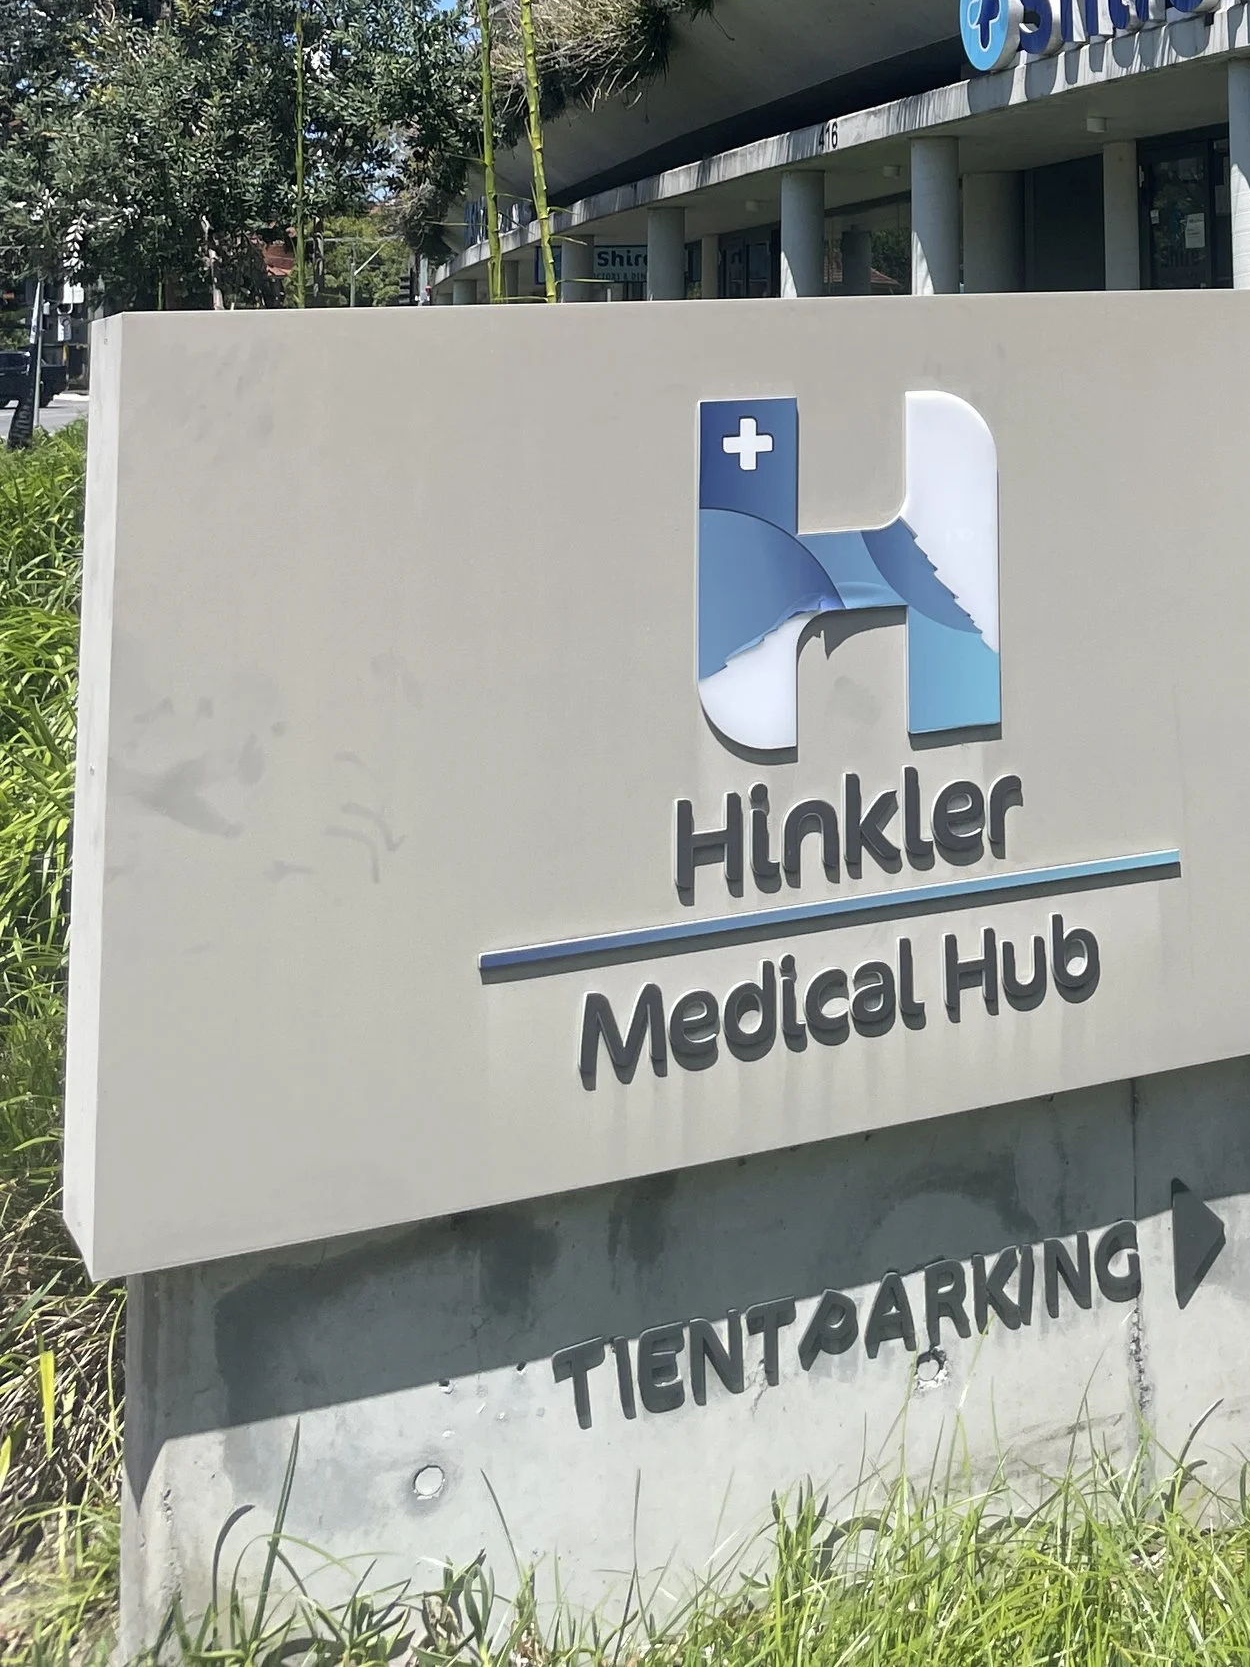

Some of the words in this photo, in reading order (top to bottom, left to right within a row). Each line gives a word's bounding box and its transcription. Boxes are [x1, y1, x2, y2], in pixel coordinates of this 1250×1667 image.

[818, 121, 839, 151] 416
[674, 765, 1023, 890] Hinkler
[578, 936, 925, 1076] Medical
[942, 912, 1100, 1014] Hub
